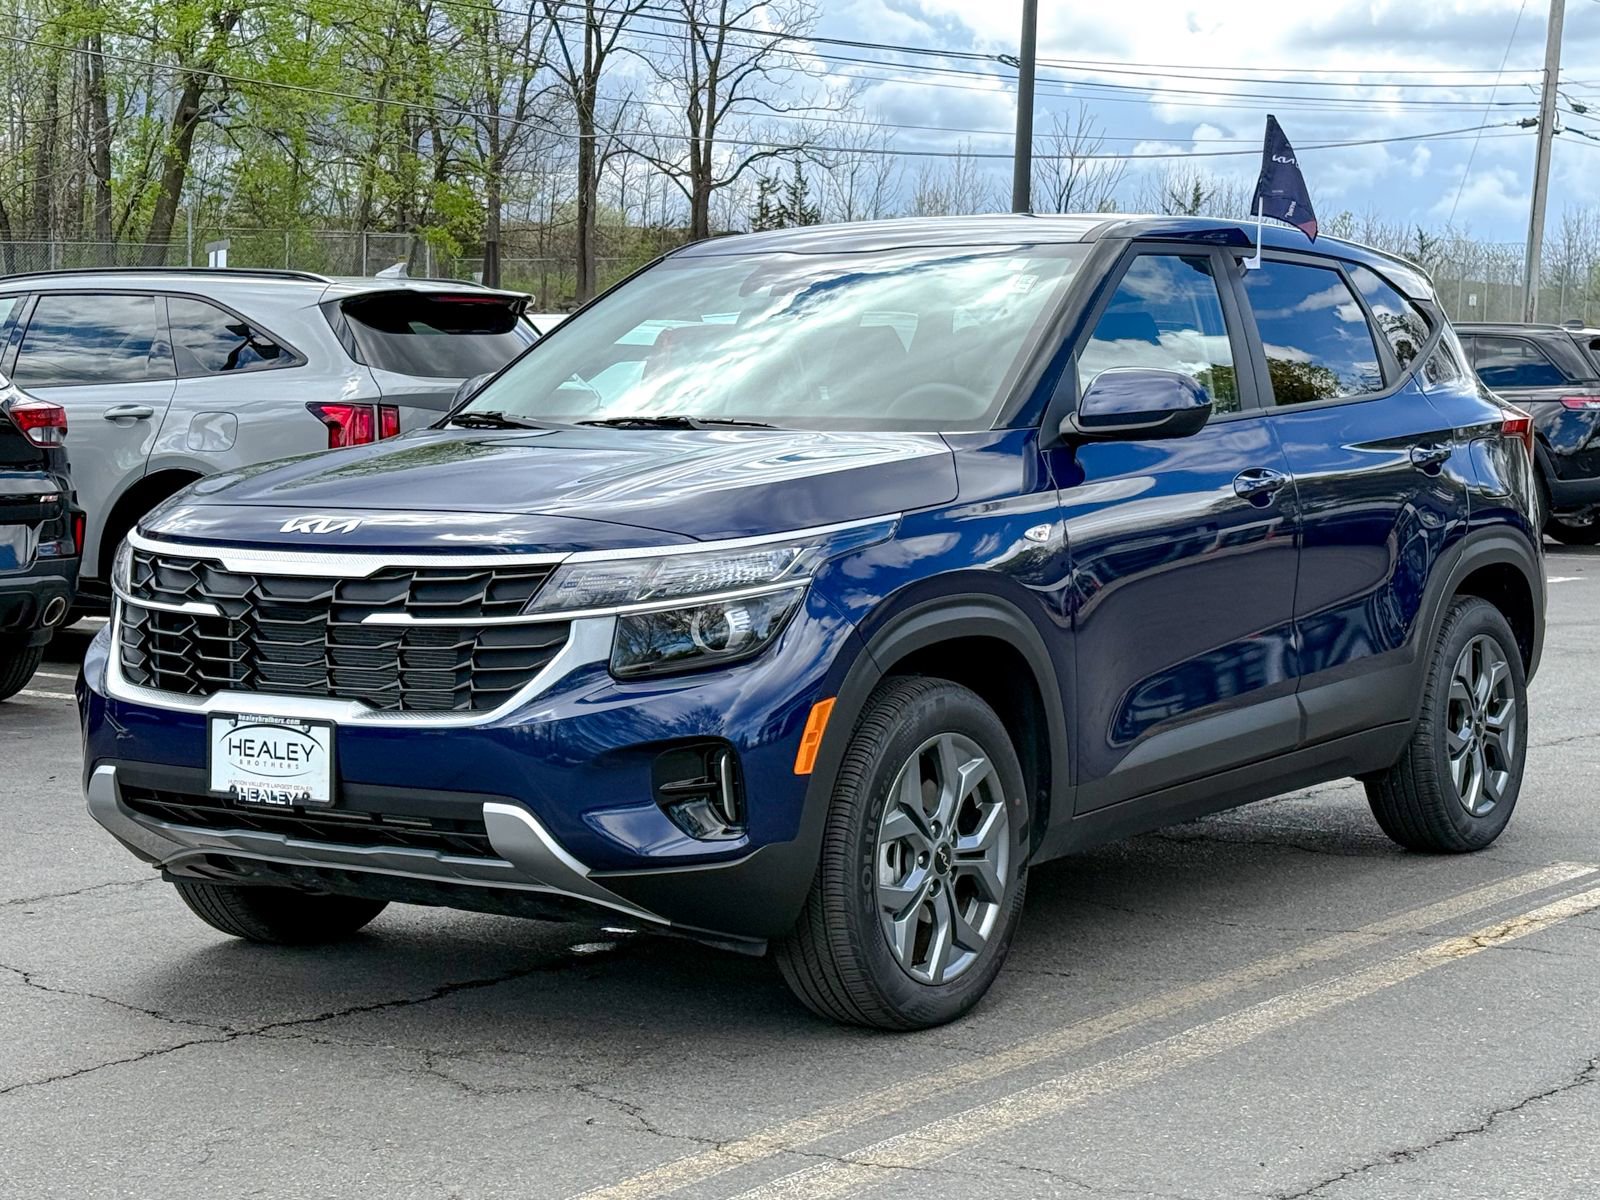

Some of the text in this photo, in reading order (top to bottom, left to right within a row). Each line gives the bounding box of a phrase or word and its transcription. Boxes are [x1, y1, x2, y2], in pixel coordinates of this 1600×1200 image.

[280, 519, 361, 534] KIA
[228, 737, 315, 762] HEALEY
[239, 759, 299, 770] BROTHERS
[238, 787, 298, 805] HEALEY
[862, 798, 881, 914] SOLUS
